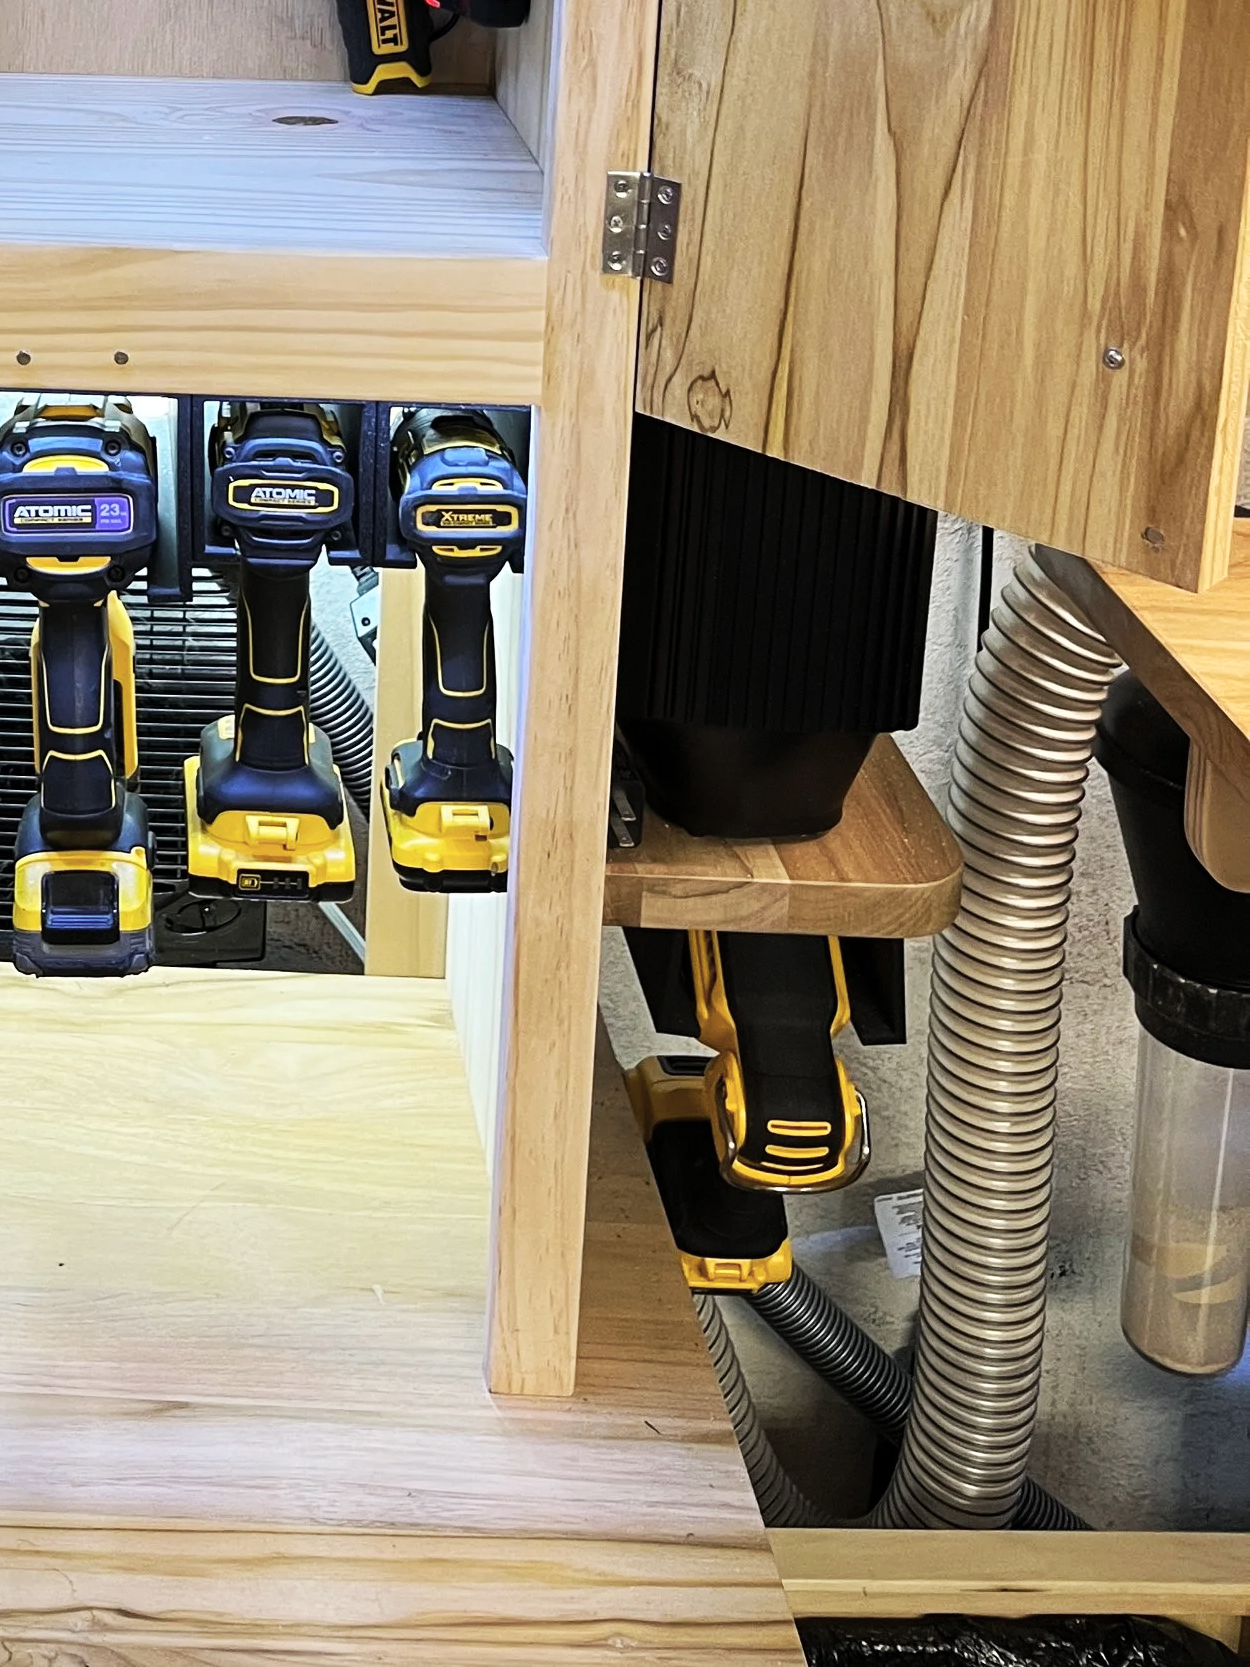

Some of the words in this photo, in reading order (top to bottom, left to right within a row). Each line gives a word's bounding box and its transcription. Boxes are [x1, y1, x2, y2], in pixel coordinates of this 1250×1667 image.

[251, 487, 316, 500] ATOMIC
[14, 504, 92, 517] ATOMIC
[100, 503, 120, 517] 23
[441, 511, 493, 521] XTREME
